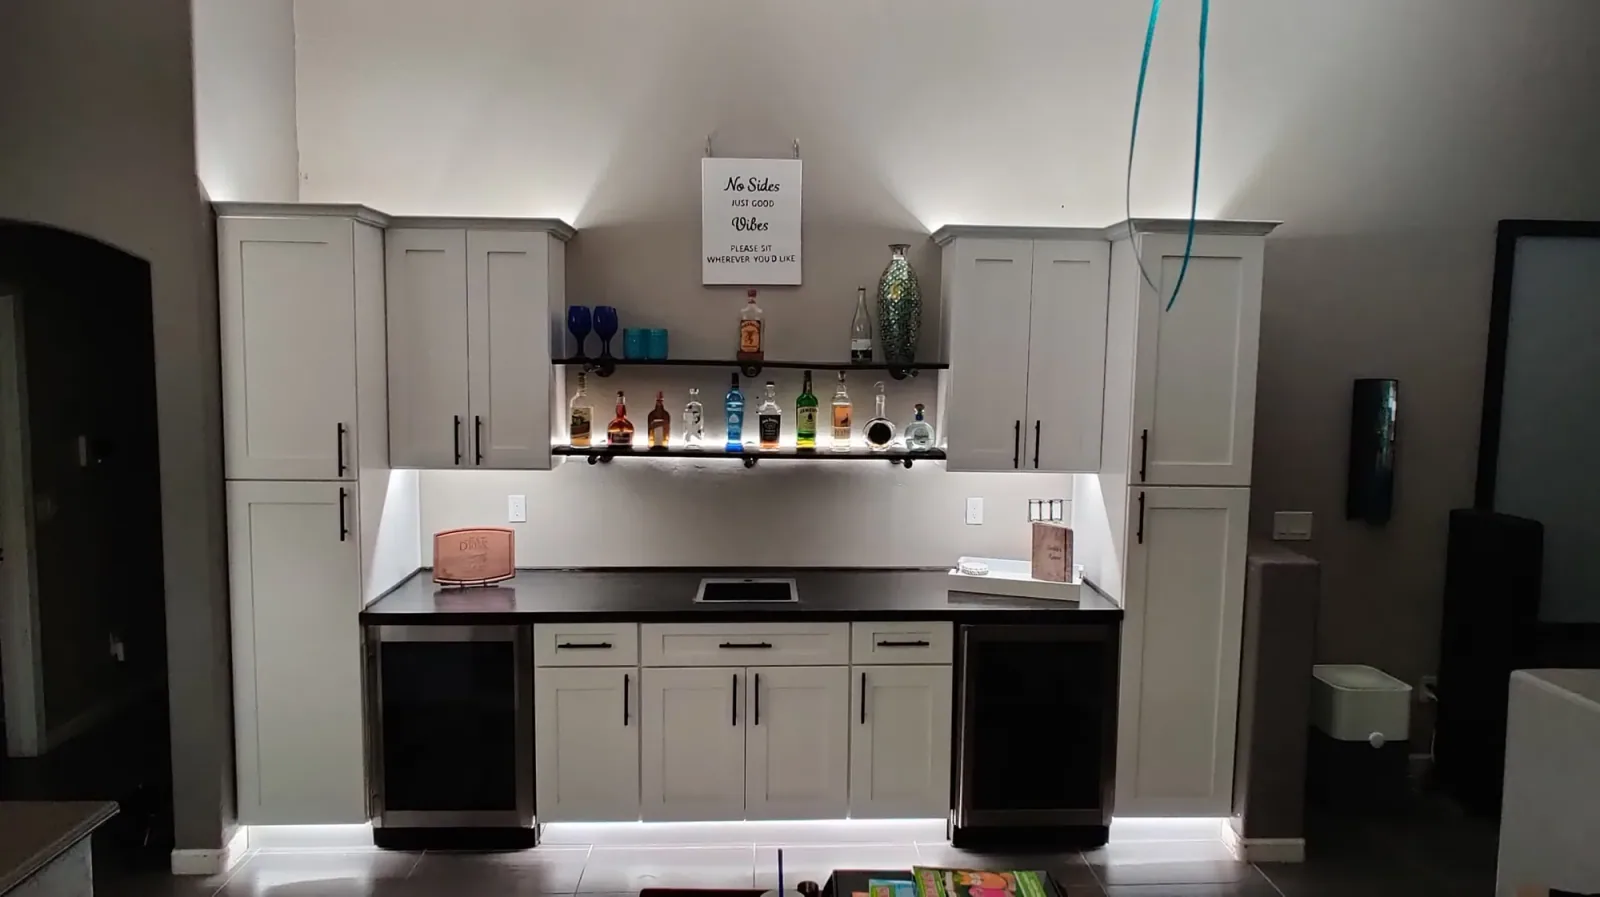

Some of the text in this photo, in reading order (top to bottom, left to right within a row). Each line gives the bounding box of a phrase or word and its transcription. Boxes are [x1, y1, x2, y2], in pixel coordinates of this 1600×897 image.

[724, 176, 780, 192] No Sides
[732, 199, 775, 207] JUST GOOD
[731, 216, 769, 231] Vibes
